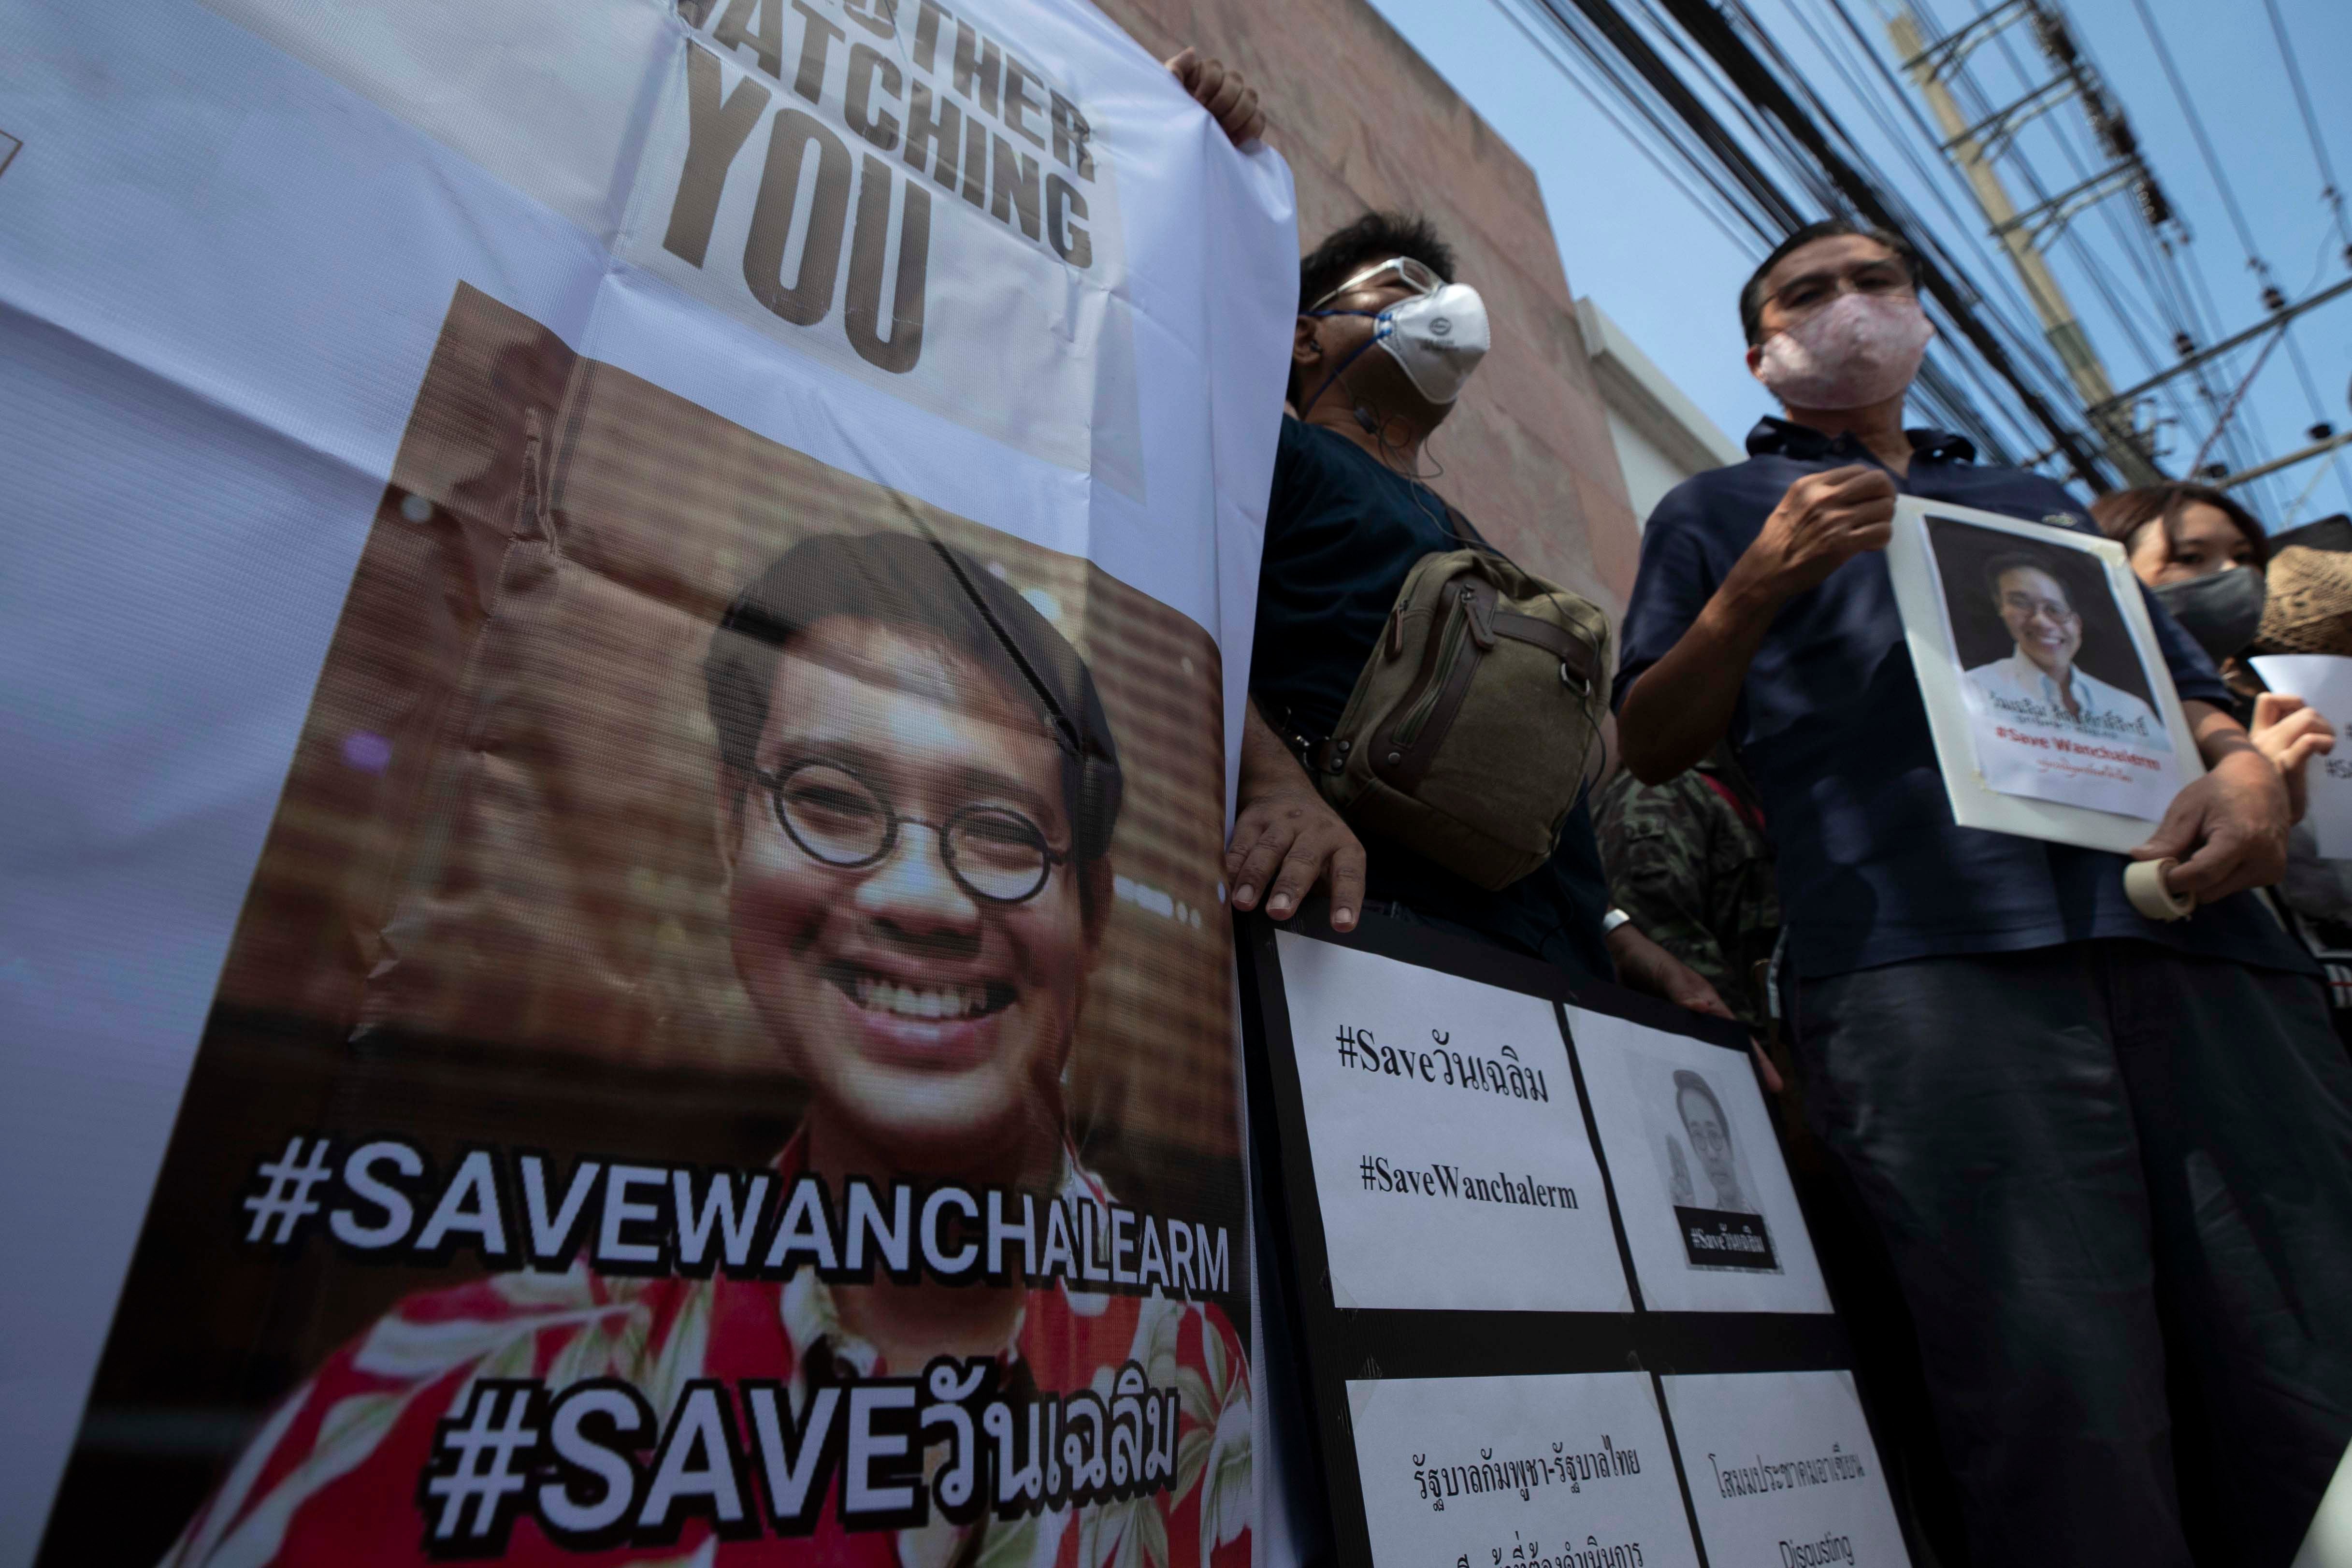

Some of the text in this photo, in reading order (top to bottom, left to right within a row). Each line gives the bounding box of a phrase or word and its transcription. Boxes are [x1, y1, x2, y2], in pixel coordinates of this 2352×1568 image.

[663, 42, 932, 374] YOU
[1336, 1024, 1548, 1103] #Saveวันเฉลิม
[245, 1136, 1230, 1294] #SAVEWANCHALEARM
[1360, 1154, 1579, 1209] #SaveWanchalerm
[430, 1361, 1180, 1539] #SAVEวันเฉลิม
[1412, 1434, 1641, 1511] รัฐบาลกัมพูชา-รัฐบาลไทย
